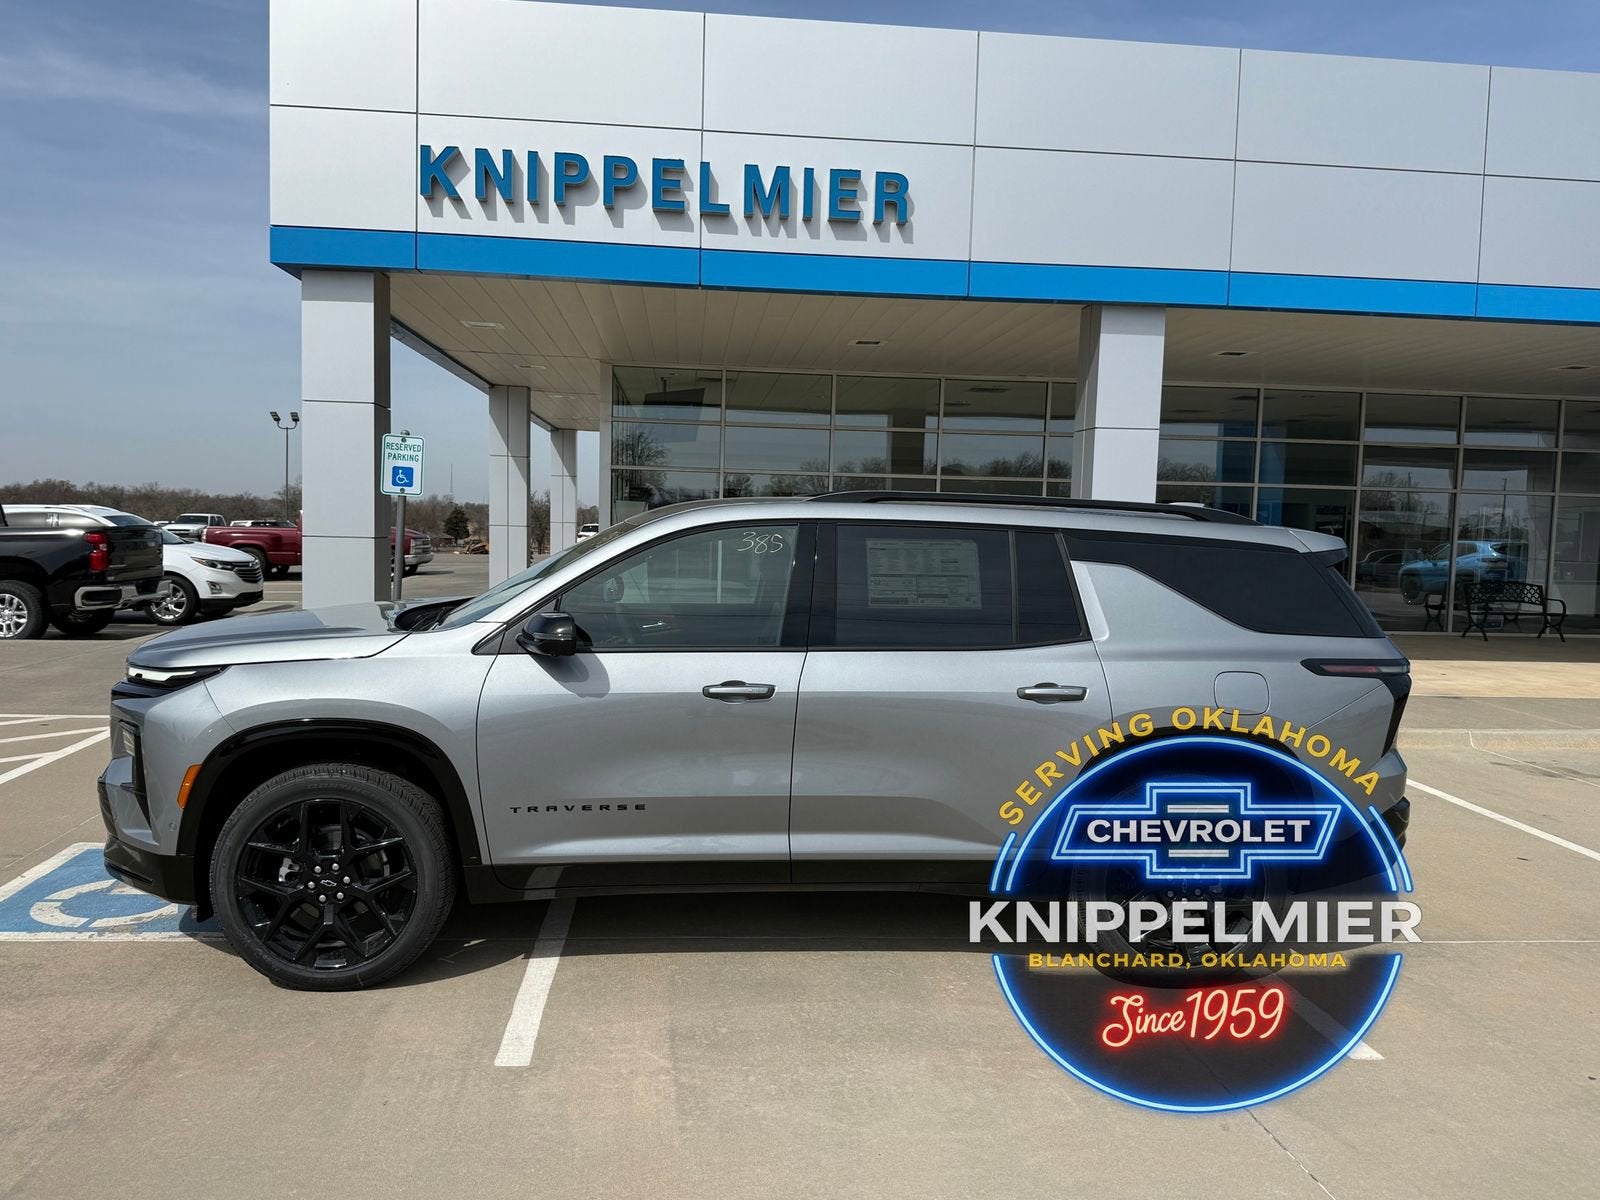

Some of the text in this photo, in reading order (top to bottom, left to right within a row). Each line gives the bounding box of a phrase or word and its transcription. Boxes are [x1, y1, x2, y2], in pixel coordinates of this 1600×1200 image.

[420, 144, 909, 224] KNIPPELMIER
[385, 442, 422, 452] RESERVED
[387, 452, 420, 462] PARKING
[737, 531, 783, 554] 385
[509, 804, 646, 813] TRAVERSE
